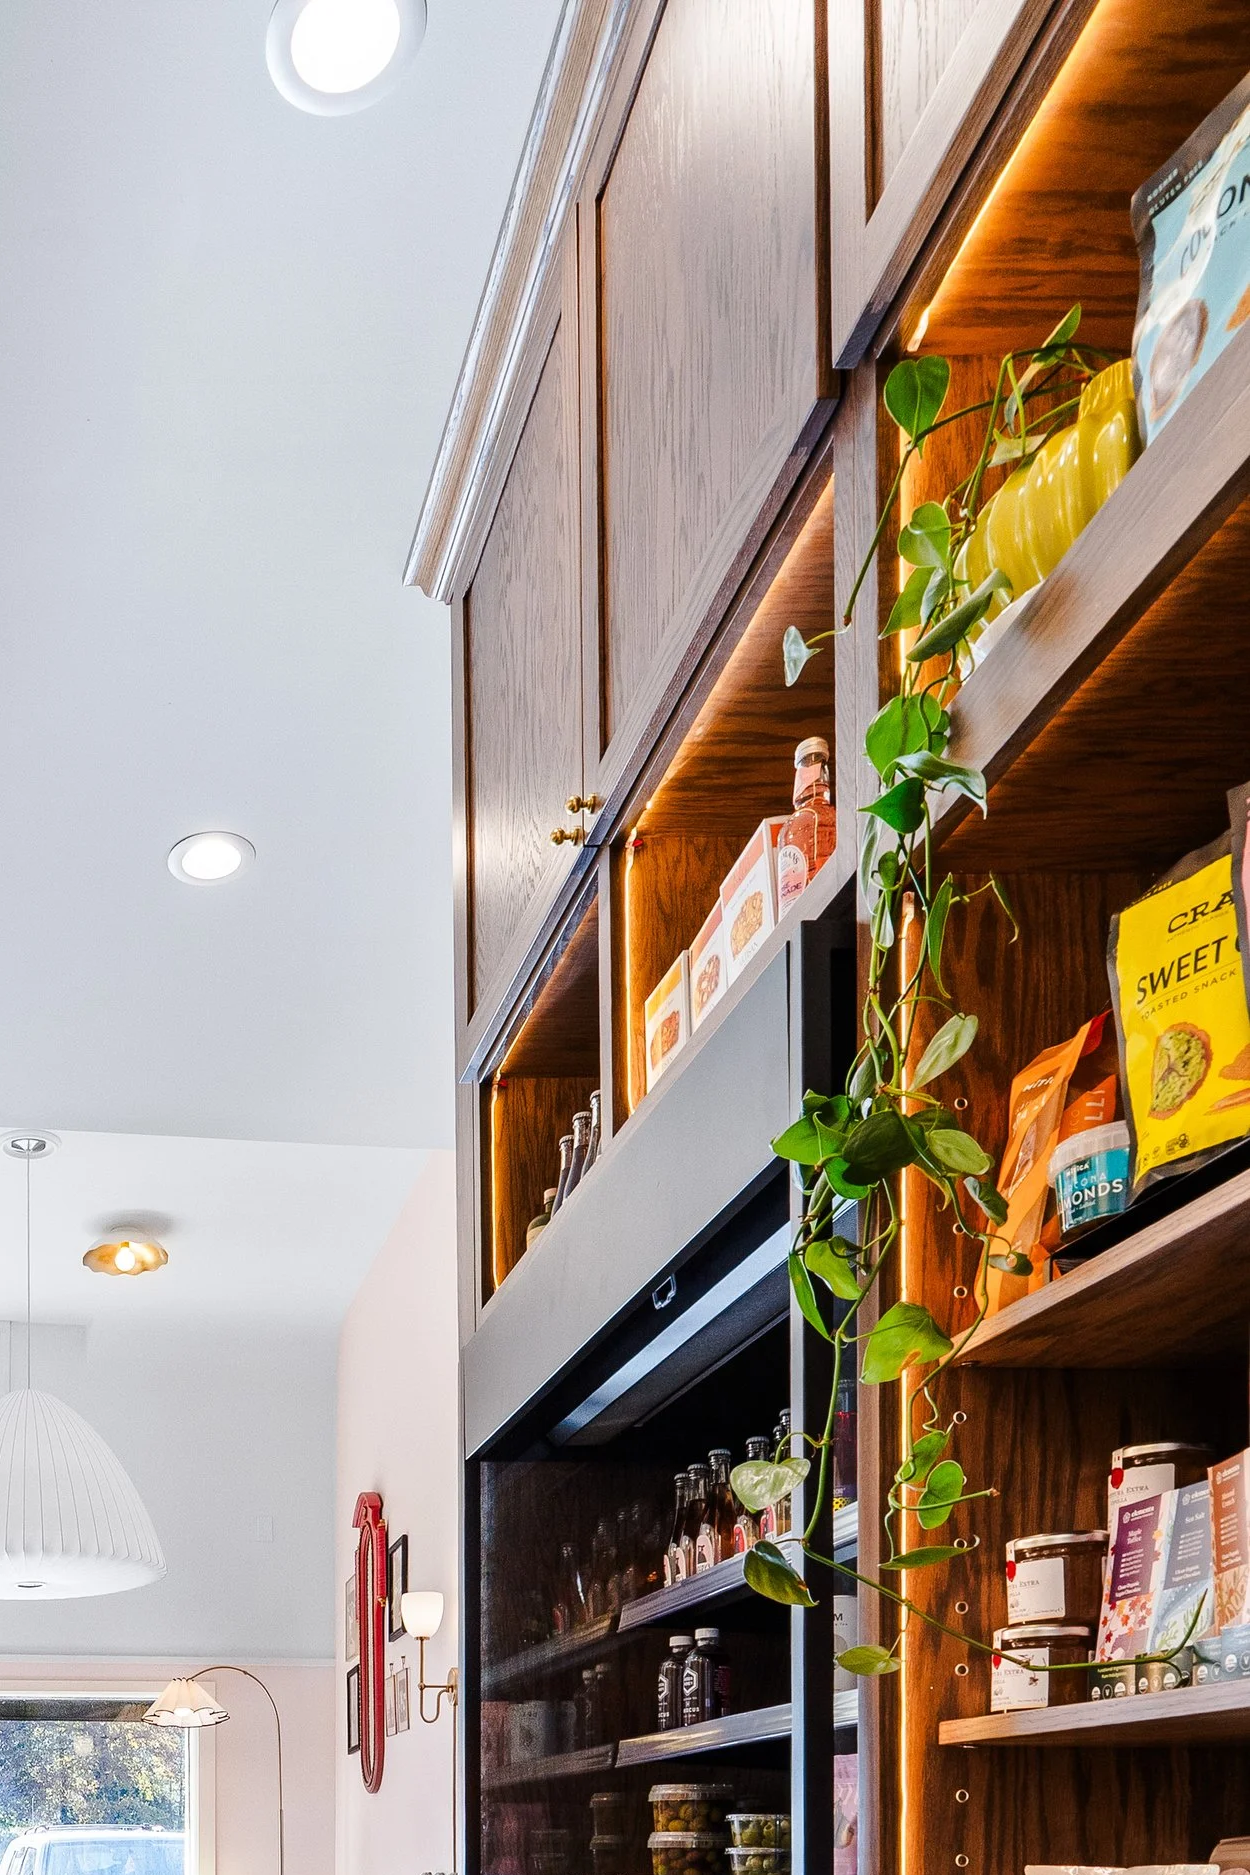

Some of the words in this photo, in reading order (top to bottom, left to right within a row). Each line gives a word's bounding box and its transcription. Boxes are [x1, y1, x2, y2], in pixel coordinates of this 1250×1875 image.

[1136, 934, 1229, 1006] SWEET
[1140, 990, 1189, 1022] TOASTED
[1193, 967, 1238, 994] SNACK
[1019, 1579, 1040, 1588] EXTRA
